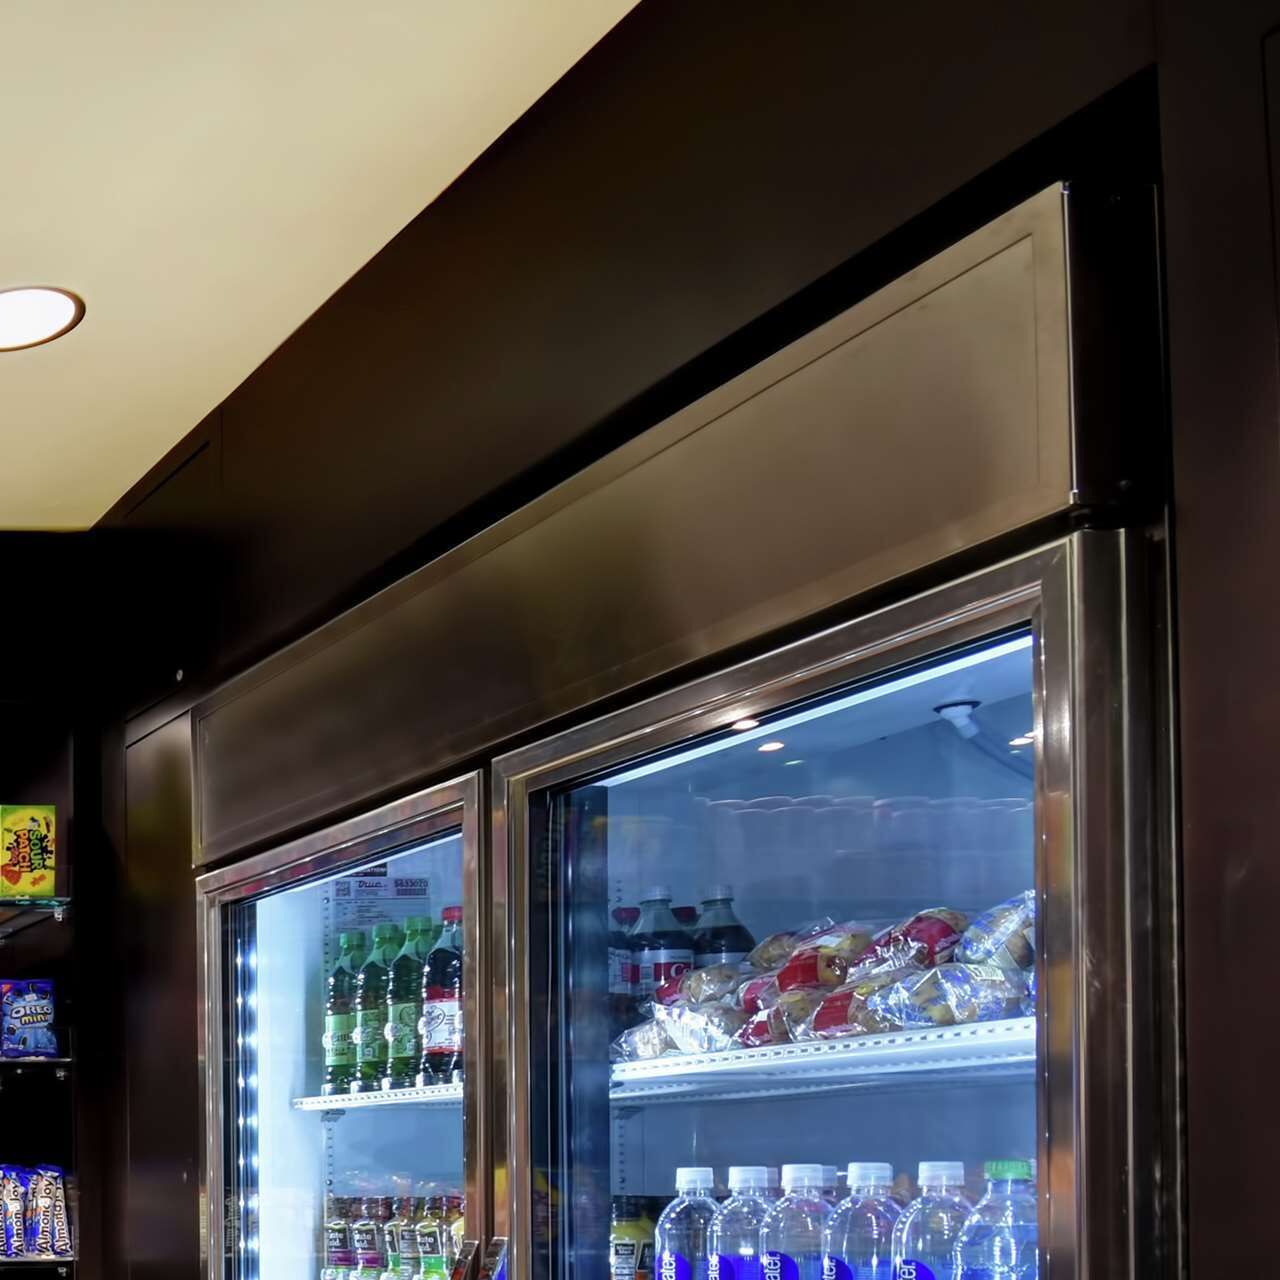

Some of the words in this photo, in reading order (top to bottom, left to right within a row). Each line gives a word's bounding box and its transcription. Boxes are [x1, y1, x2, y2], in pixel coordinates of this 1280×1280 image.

[15, 829, 32, 872] PATCH
[29, 830, 45, 870] SOUR
[11, 1004, 52, 1018] OREO
[43, 1177, 54, 1200] Joy
